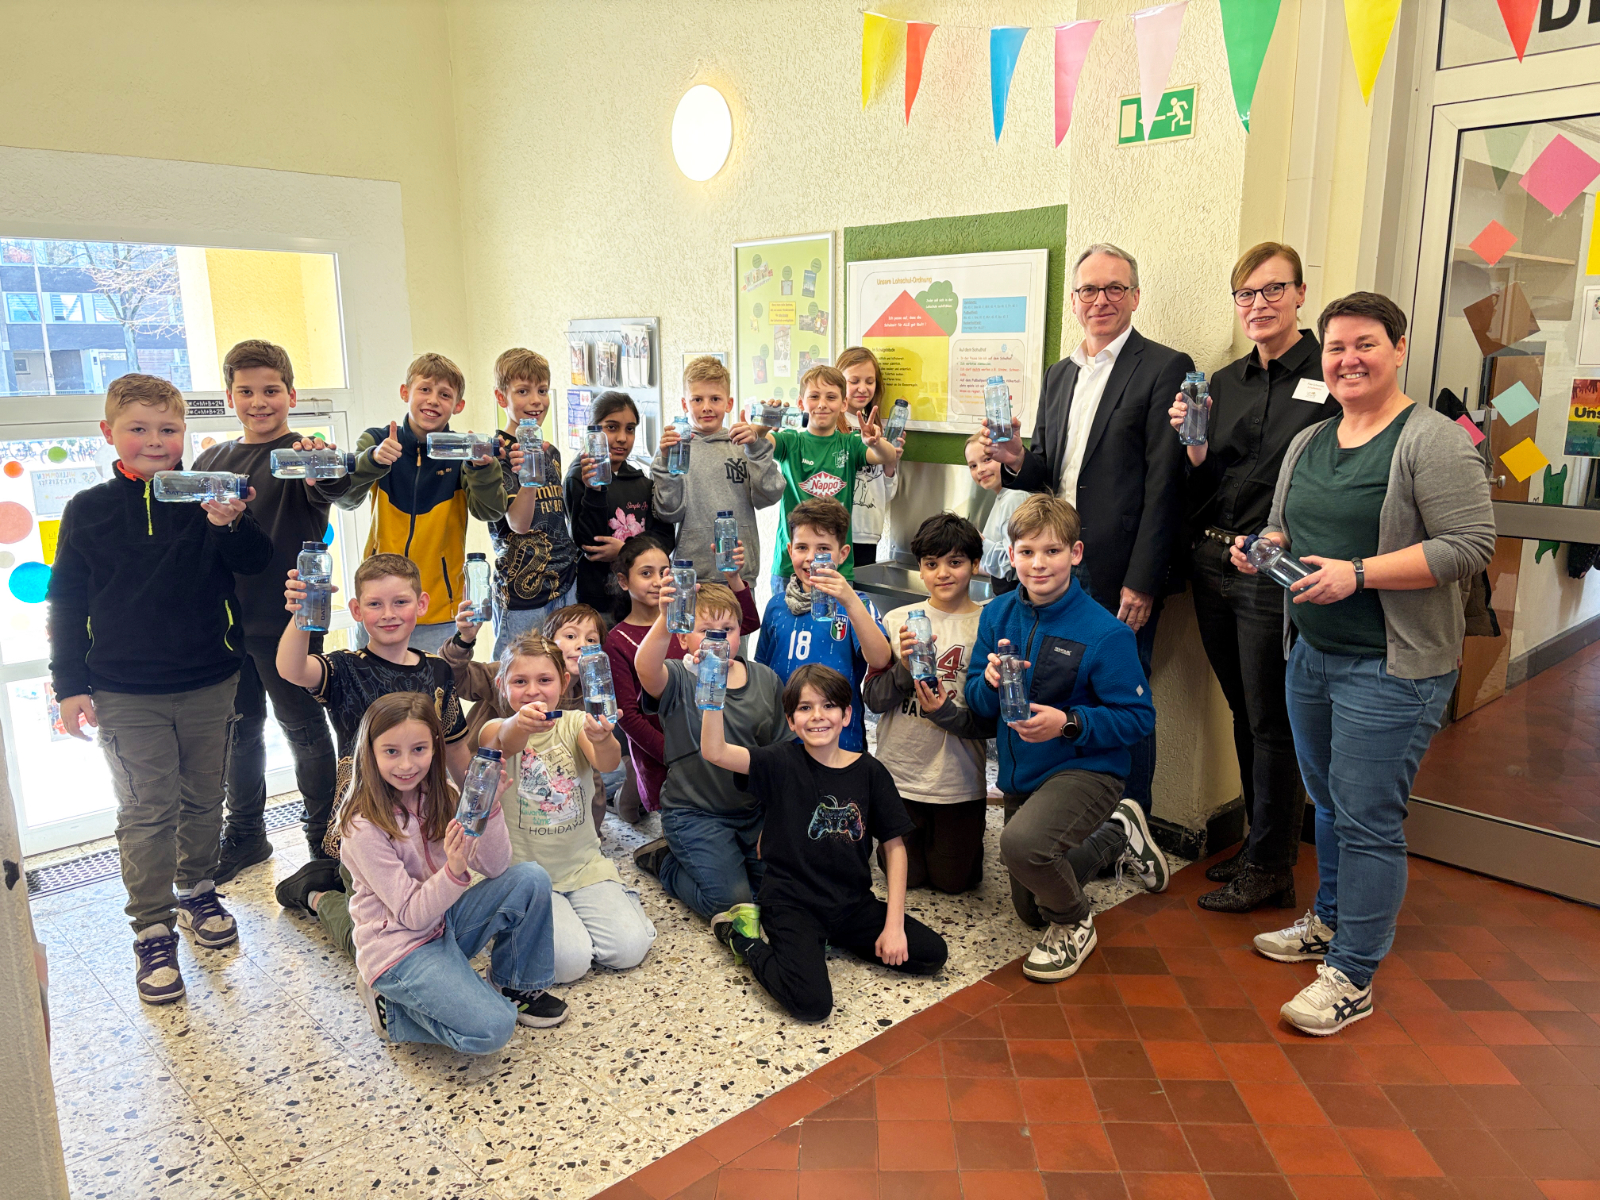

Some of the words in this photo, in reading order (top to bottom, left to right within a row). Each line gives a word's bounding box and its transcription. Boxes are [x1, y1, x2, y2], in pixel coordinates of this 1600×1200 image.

[811, 479, 839, 492] Nappo
[787, 630, 812, 661] 18
[529, 821, 579, 836] HOLIDAY
